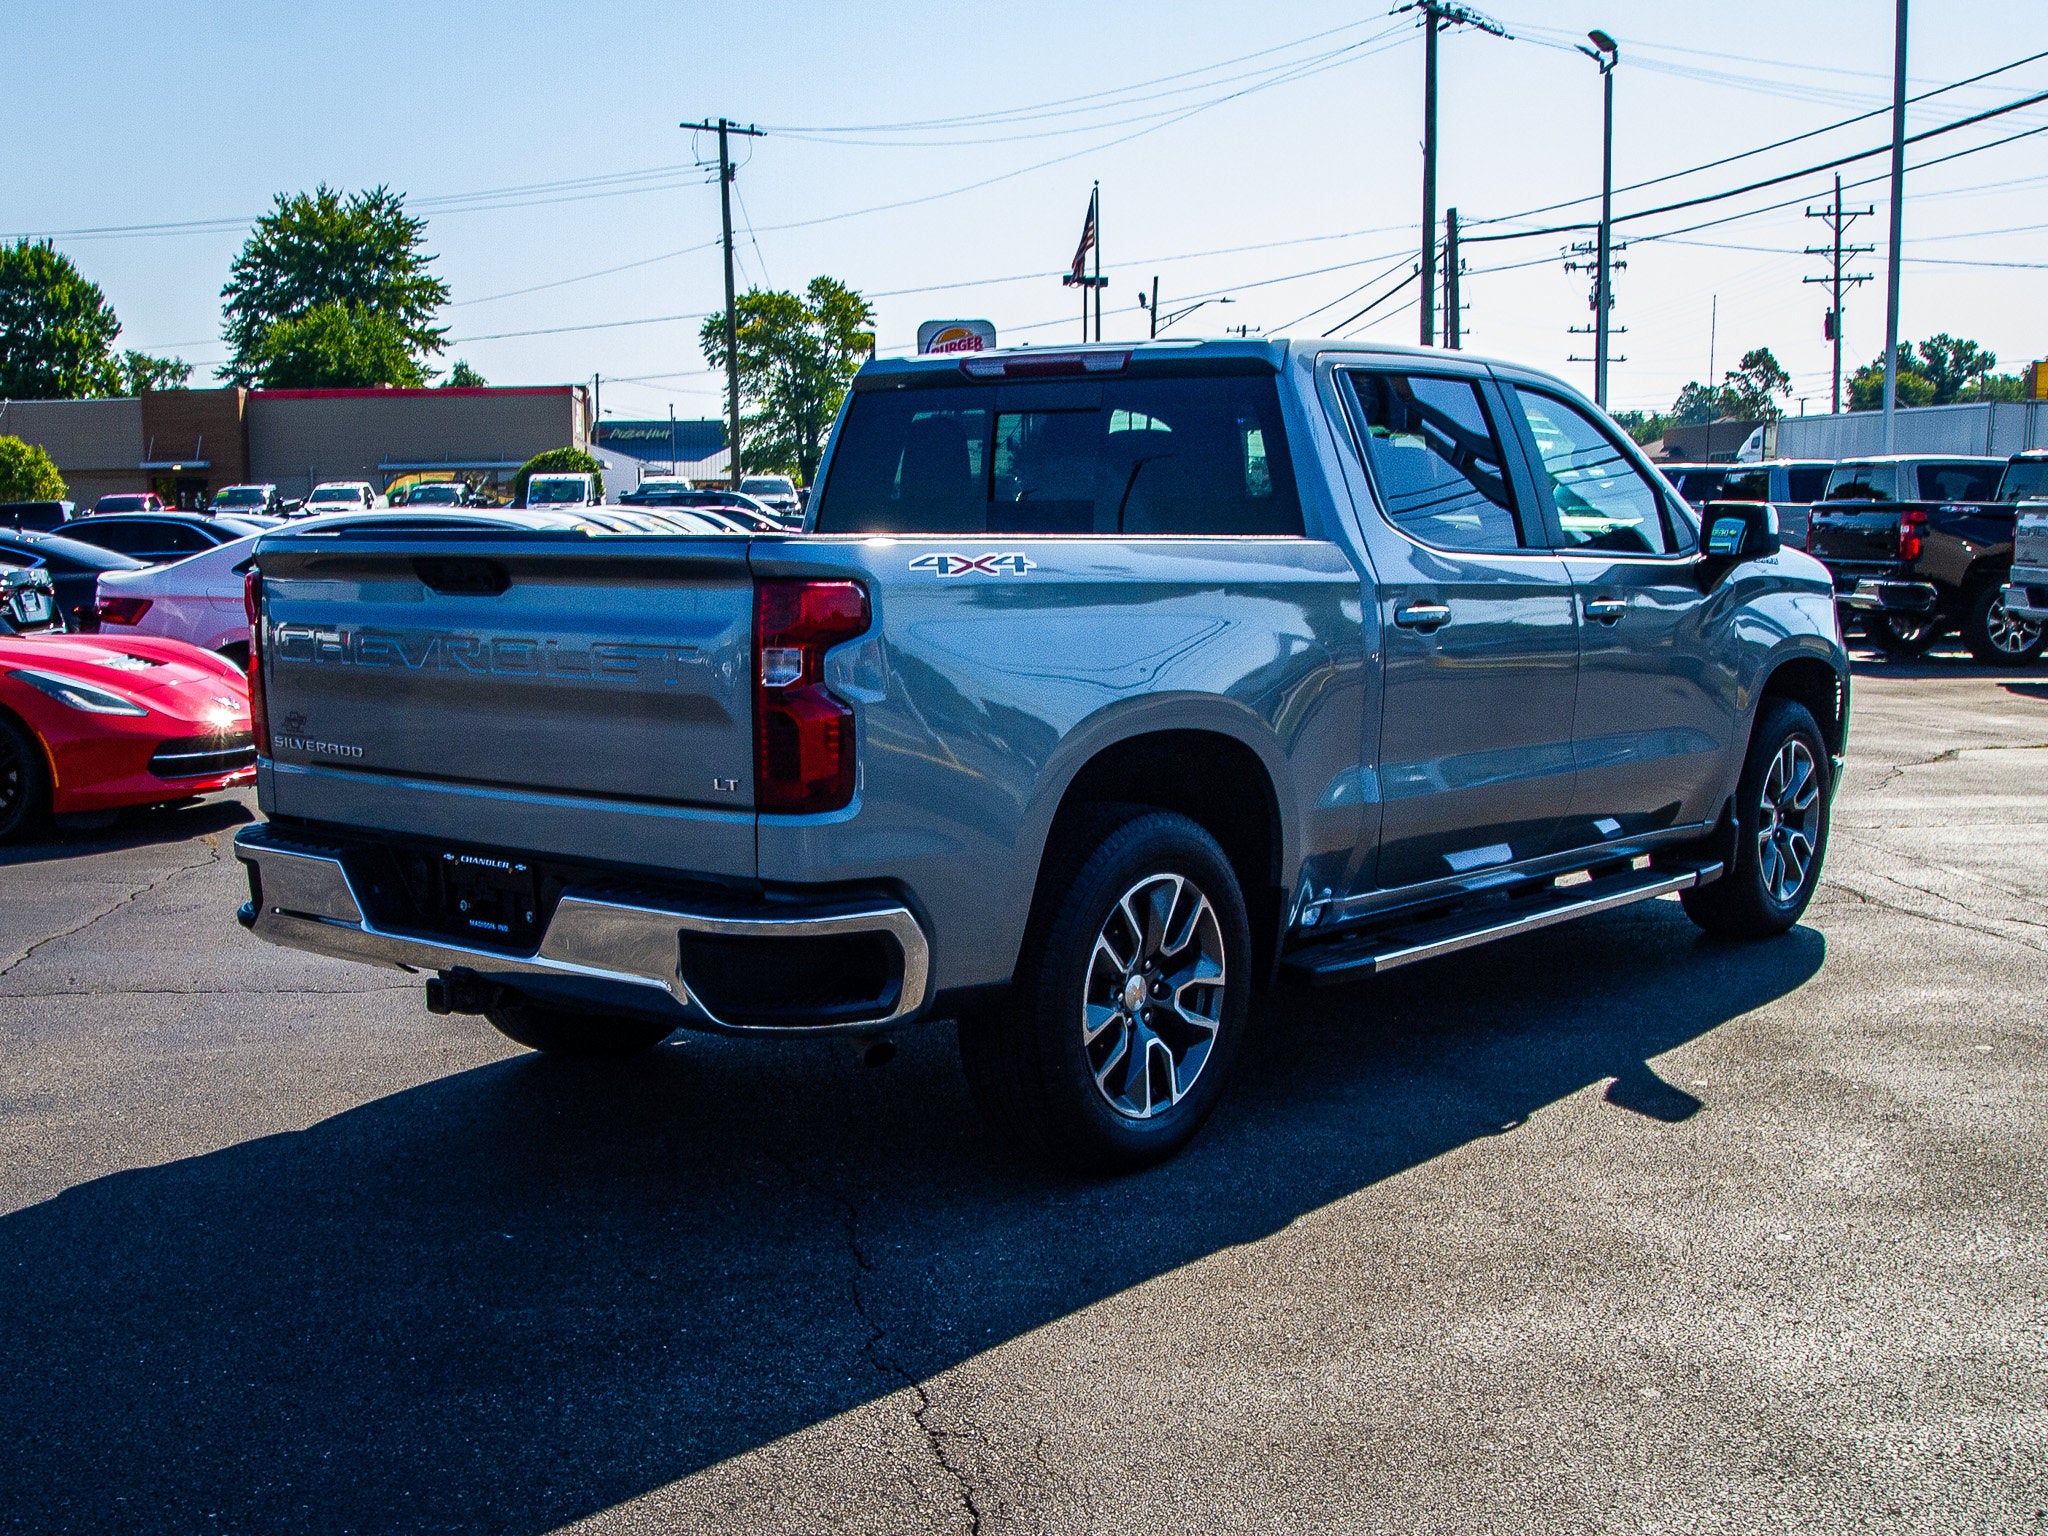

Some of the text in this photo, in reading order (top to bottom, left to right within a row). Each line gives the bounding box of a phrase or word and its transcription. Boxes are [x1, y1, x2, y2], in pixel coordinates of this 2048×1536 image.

[274, 621, 699, 685] CHEVROLET
[274, 735, 363, 758] SILVERADO
[713, 778, 739, 791] LT
[460, 855, 510, 870] CHANDLER
